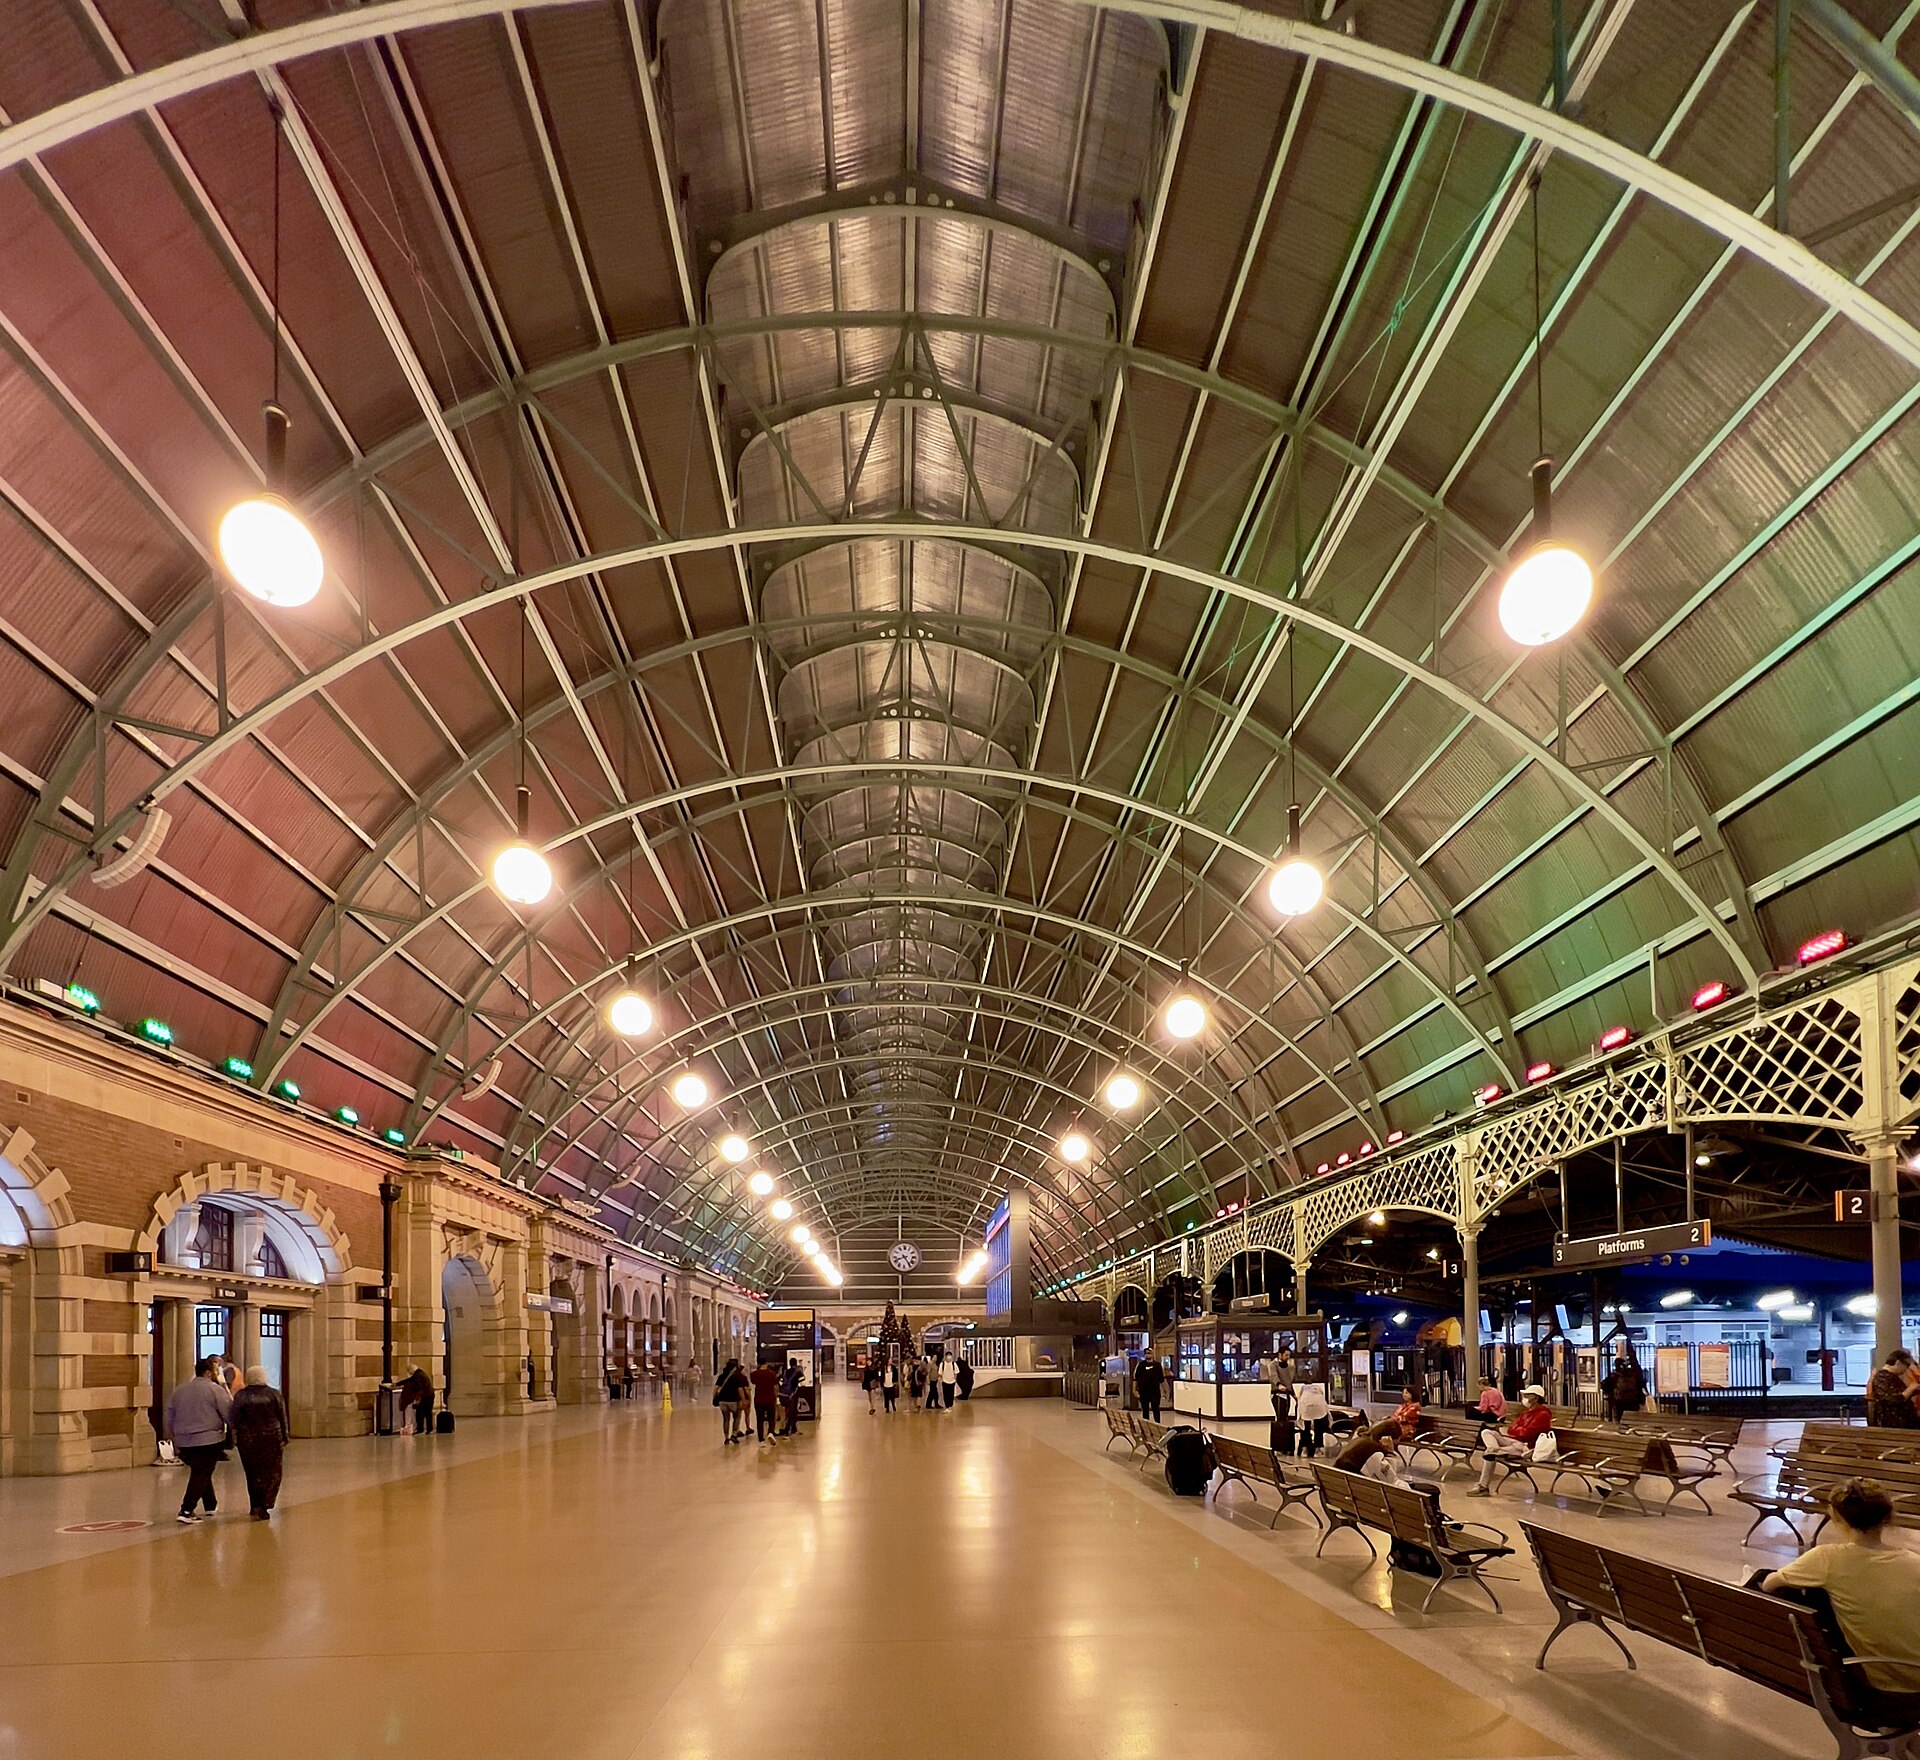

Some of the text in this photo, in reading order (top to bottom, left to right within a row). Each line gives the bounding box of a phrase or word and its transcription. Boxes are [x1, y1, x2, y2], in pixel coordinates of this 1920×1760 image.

[1851, 1196, 1863, 1214] 2
[1556, 1227, 1700, 1262] 3 Platforms 2
[1450, 1263, 1458, 1274] 3
[1285, 1290, 1292, 1299] 4
